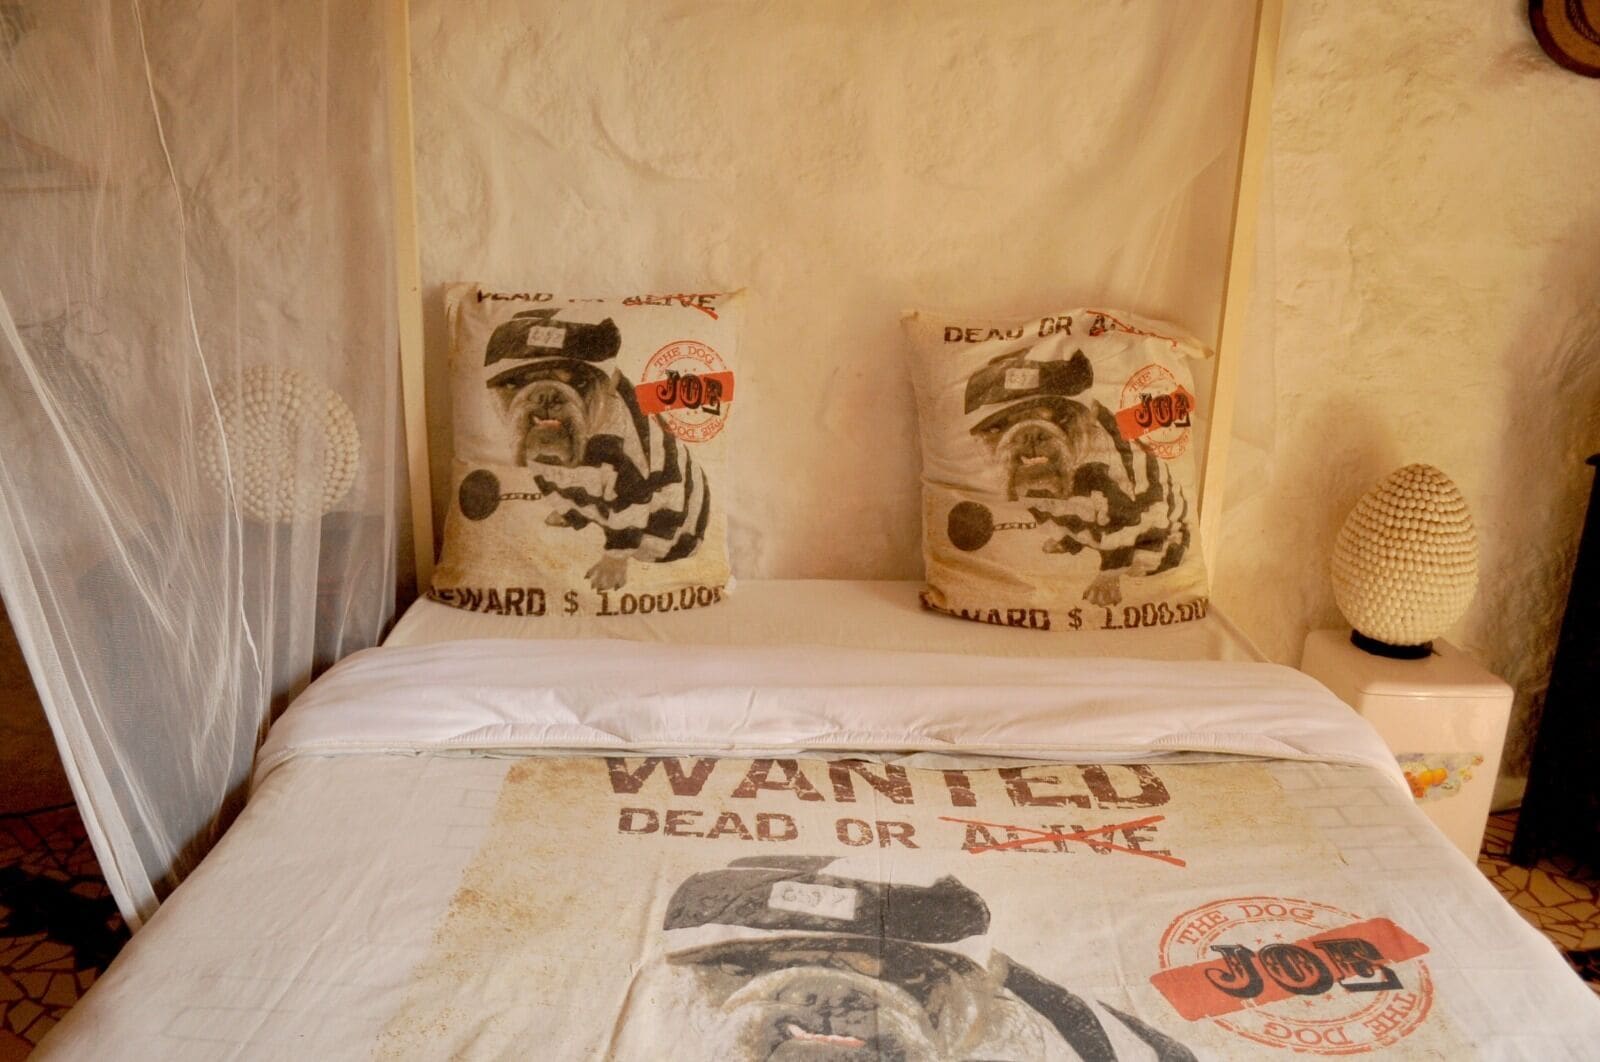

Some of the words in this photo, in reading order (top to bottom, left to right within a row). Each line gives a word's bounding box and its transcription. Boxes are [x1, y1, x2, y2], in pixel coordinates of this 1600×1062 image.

[1038, 316, 1073, 338] OR
[654, 346, 681, 368] THE
[687, 345, 714, 364] DOG
[656, 369, 723, 416] JOE
[1134, 392, 1192, 428] JOE
[564, 590, 579, 616] $
[1067, 605, 1083, 630] $
[617, 807, 799, 843] DEAD
[835, 817, 920, 850] OR
[1177, 909, 1230, 947] THE
[1237, 902, 1316, 922] DOG
[1205, 937, 1404, 999] JOE
[1362, 991, 1418, 1037] THE
[1263, 1021, 1354, 1047] DOG
